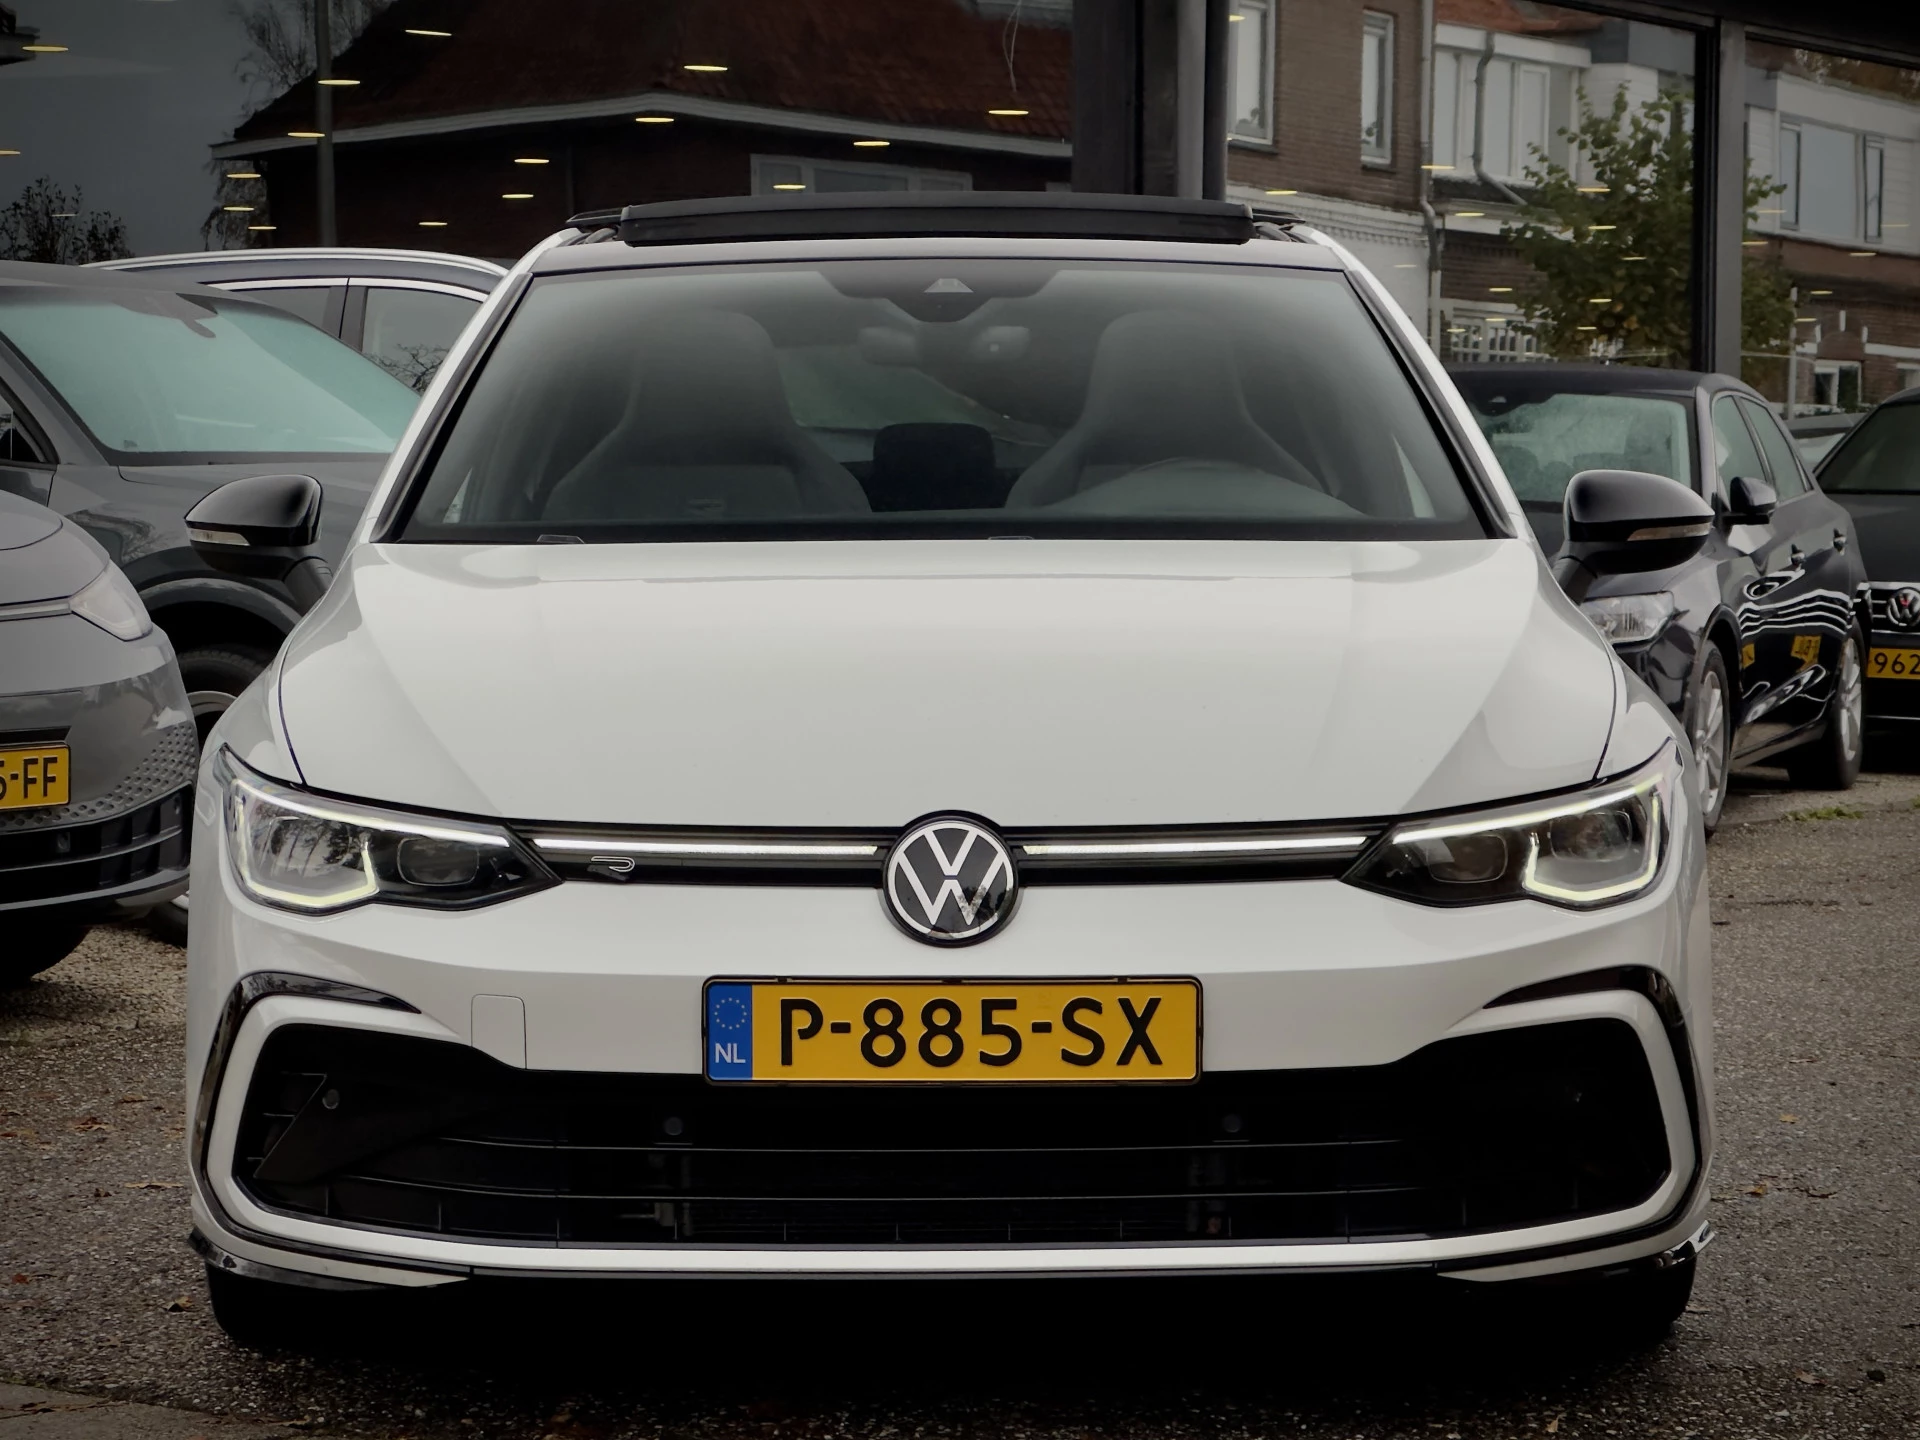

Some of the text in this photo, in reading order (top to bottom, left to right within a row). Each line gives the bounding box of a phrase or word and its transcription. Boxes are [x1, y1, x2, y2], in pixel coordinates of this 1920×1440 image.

[1874, 652, 1920, 675] 962
[888, 821, 1014, 939] VW
[715, 1043, 746, 1064] NL
[780, 997, 1163, 1068] P-885-SX
